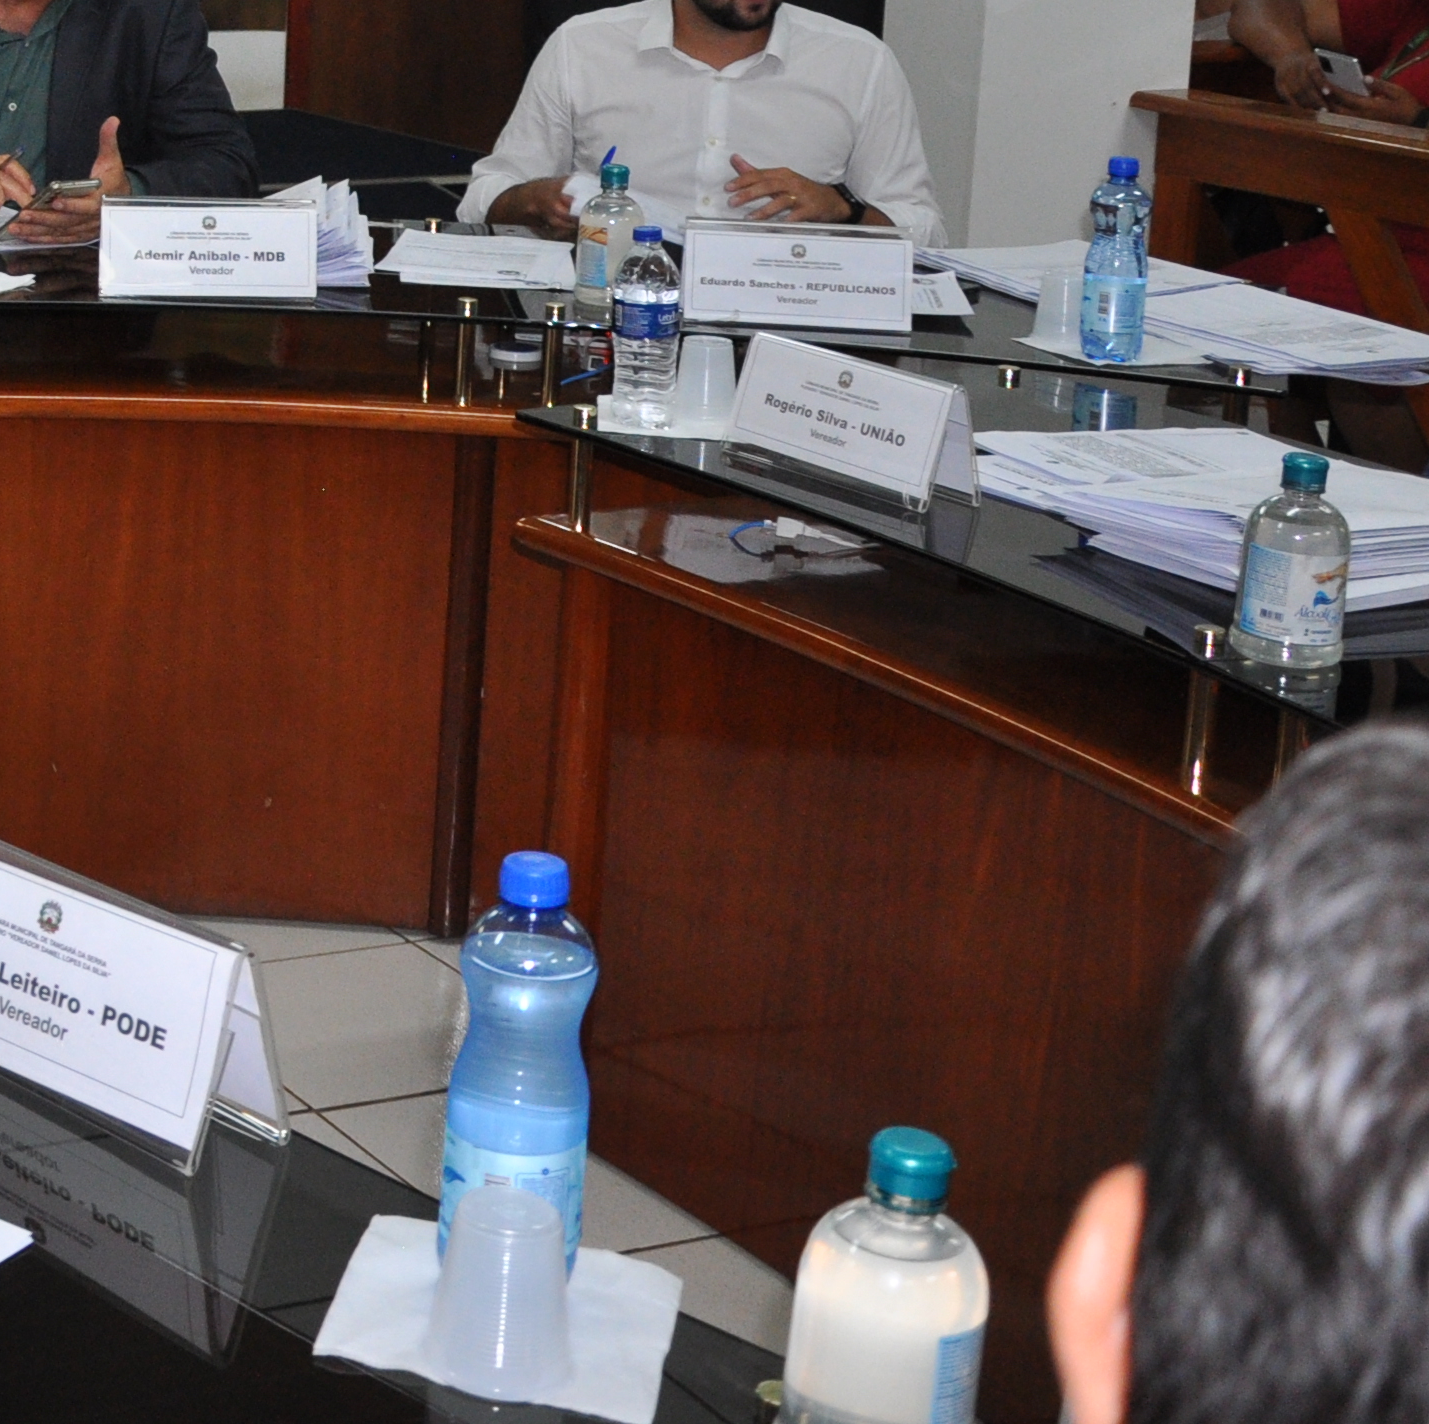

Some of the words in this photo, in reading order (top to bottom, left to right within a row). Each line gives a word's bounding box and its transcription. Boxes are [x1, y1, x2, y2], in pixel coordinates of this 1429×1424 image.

[134, 250, 183, 261] Ademir
[188, 250, 240, 262] Anibale
[254, 251, 285, 262] MDB
[189, 266, 234, 276] Vereador
[700, 276, 745, 287] Eduardo
[749, 279, 796, 290] Sanches
[806, 282, 896, 296] REPUBLICANOS
[777, 296, 818, 305] Vereador
[765, 393, 812, 418] Rogério
[816, 409, 848, 430] Silva
[860, 422, 905, 447] UNIÃO
[810, 428, 847, 447] Vereador
[11, 921, 39, 941] MUNICIPAL
[41, 935, 49, 944] DE
[101, 1005, 167, 1051] PODE
